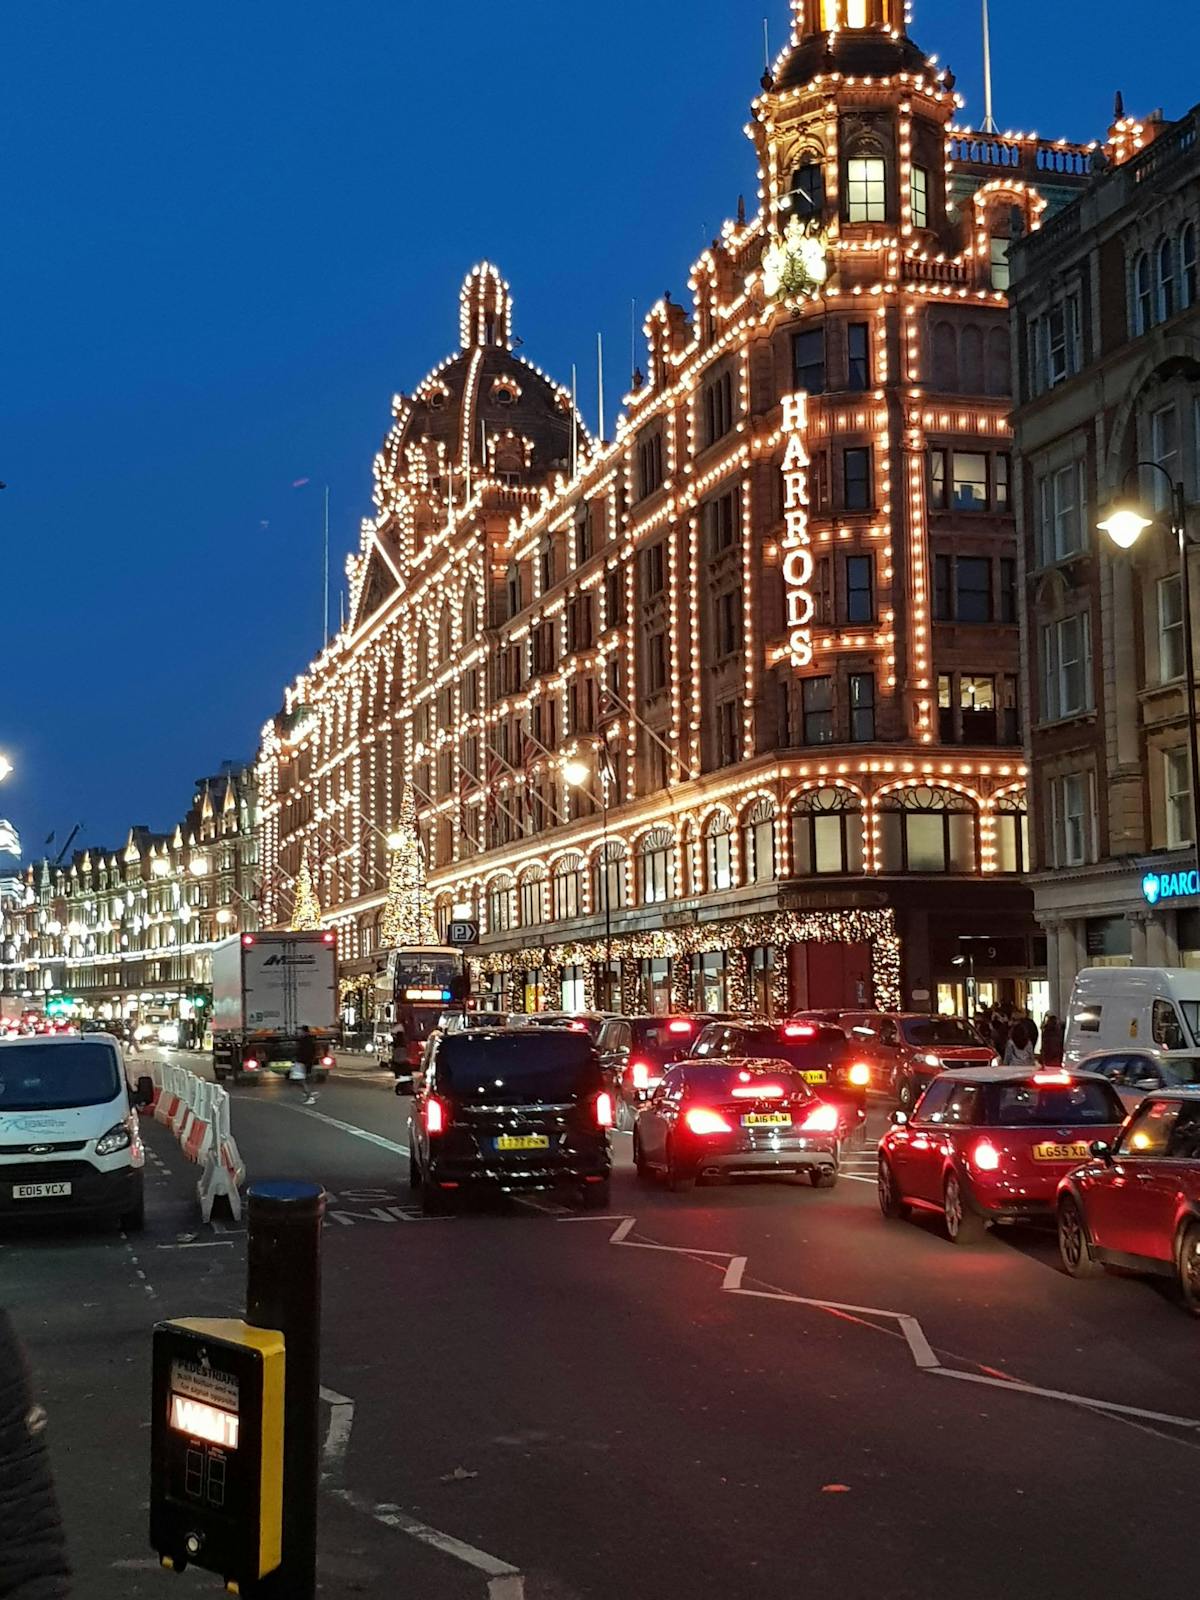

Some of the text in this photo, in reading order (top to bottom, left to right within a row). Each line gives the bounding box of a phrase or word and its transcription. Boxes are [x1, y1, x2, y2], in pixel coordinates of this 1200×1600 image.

[780, 391, 814, 667] HARRODS
[454, 926, 465, 941] P
[987, 946, 997, 959] 9
[1038, 1146, 1069, 1158] LG55
[19, 1184, 65, 1196] EO15 VCX
[174, 1397, 239, 1446] WAIT
